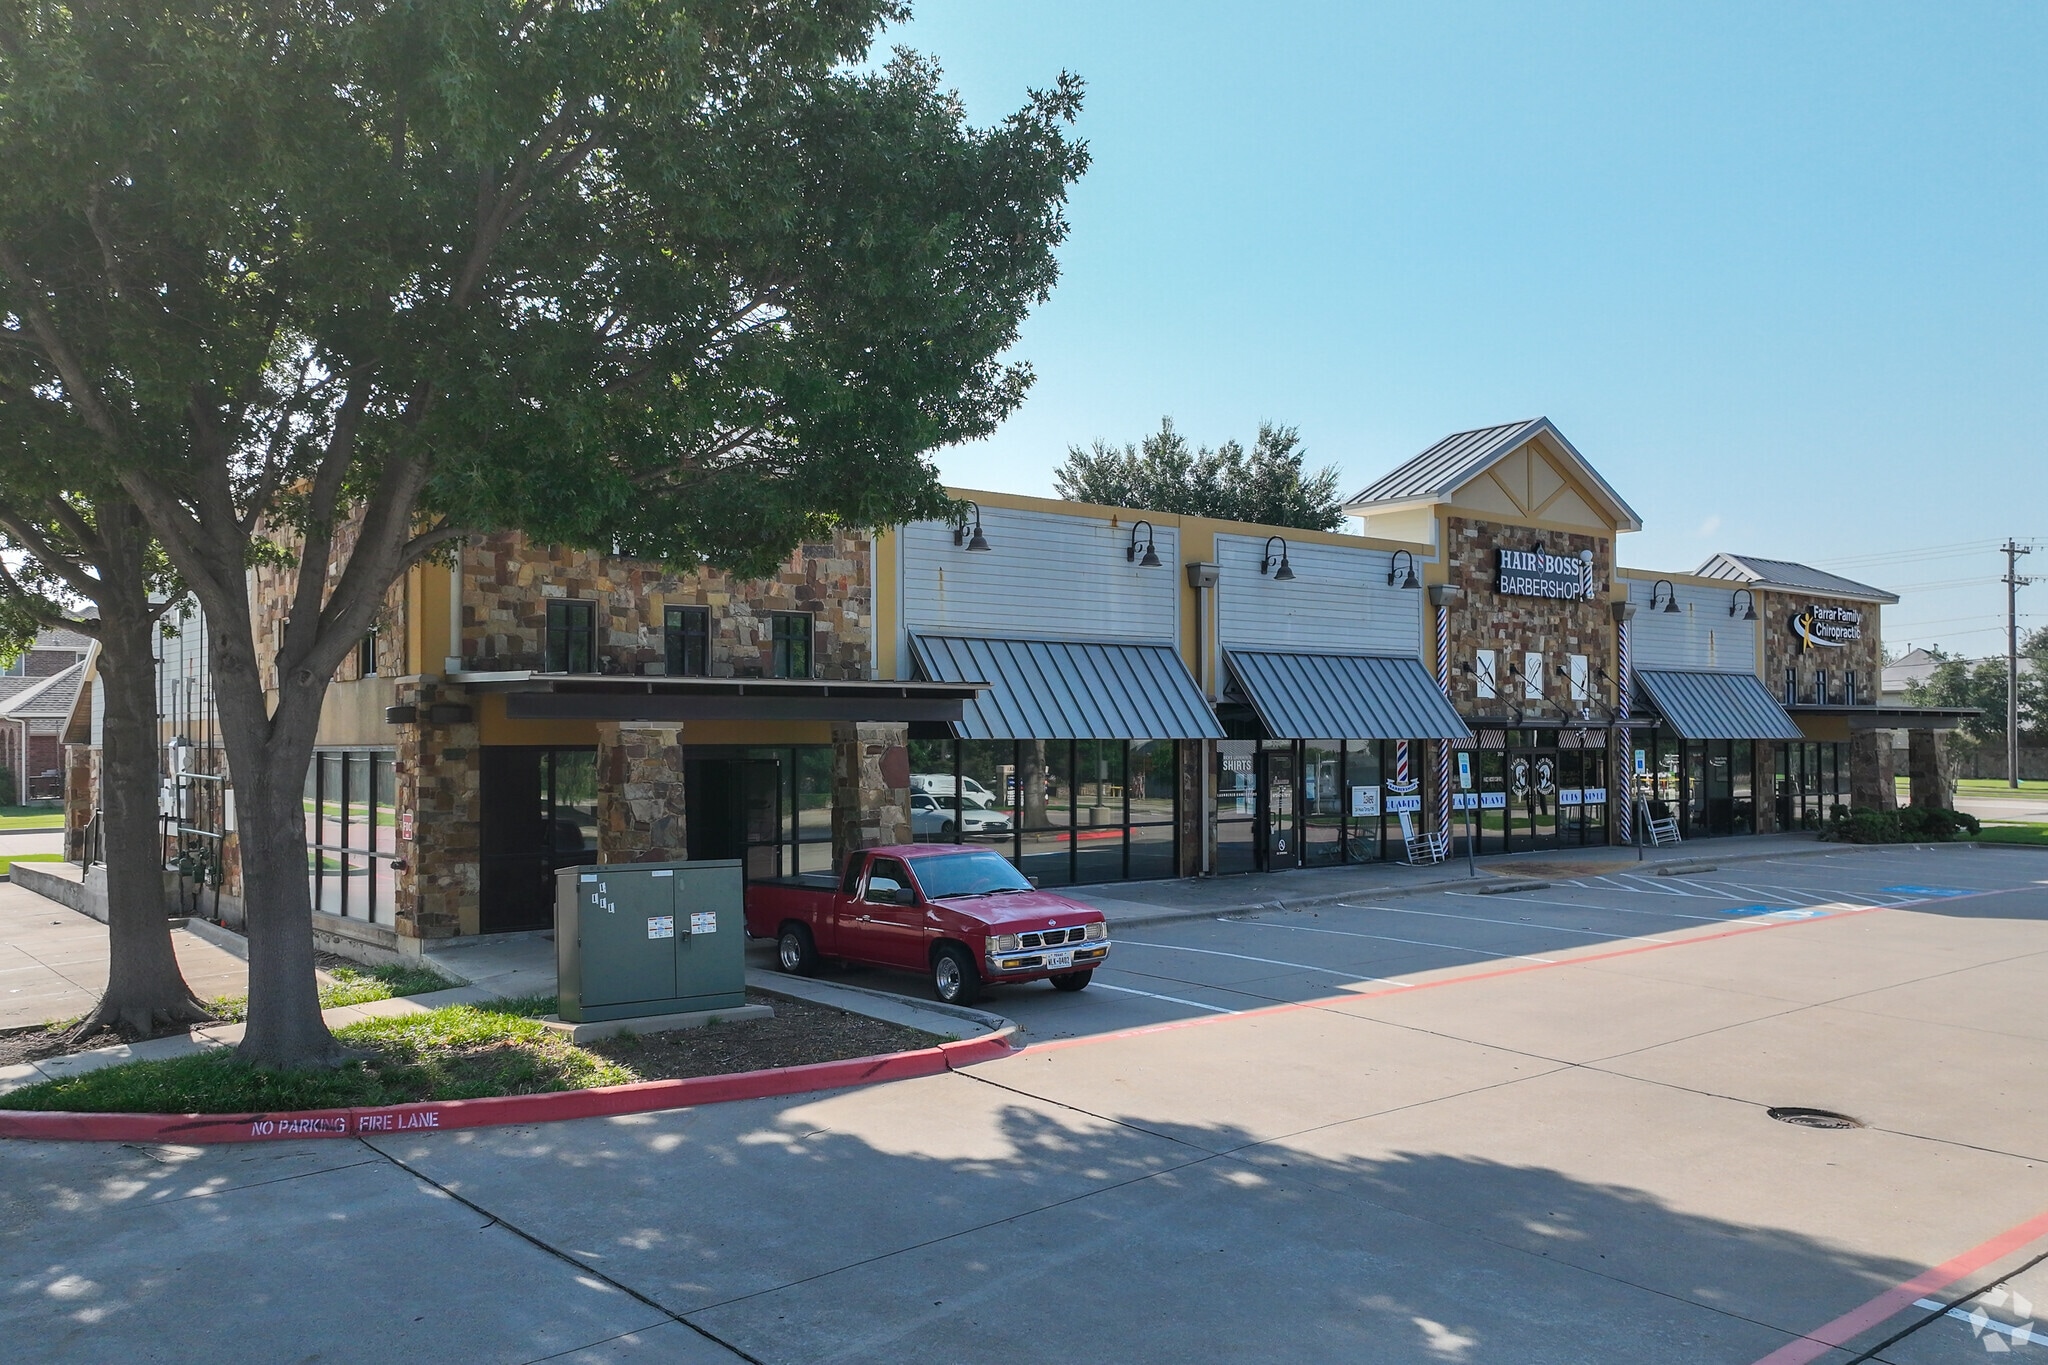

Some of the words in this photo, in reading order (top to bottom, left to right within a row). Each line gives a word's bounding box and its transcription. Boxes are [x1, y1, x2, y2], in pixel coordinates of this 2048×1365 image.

[1500, 549, 1537, 571] HAIR
[1545, 554, 1579, 576] BOSS
[1500, 575, 1580, 599] BARBERSHOP
[1813, 605, 1837, 621] Farrar
[1837, 607, 1861, 625] Family
[1816, 622, 1861, 640] Chiropractic
[1222, 760, 1252, 771] SHIRTS
[251, 1120, 274, 1137] NO
[278, 1117, 346, 1135] PARKING
[359, 1114, 393, 1132] FIRE
[397, 1111, 440, 1129] LANE
